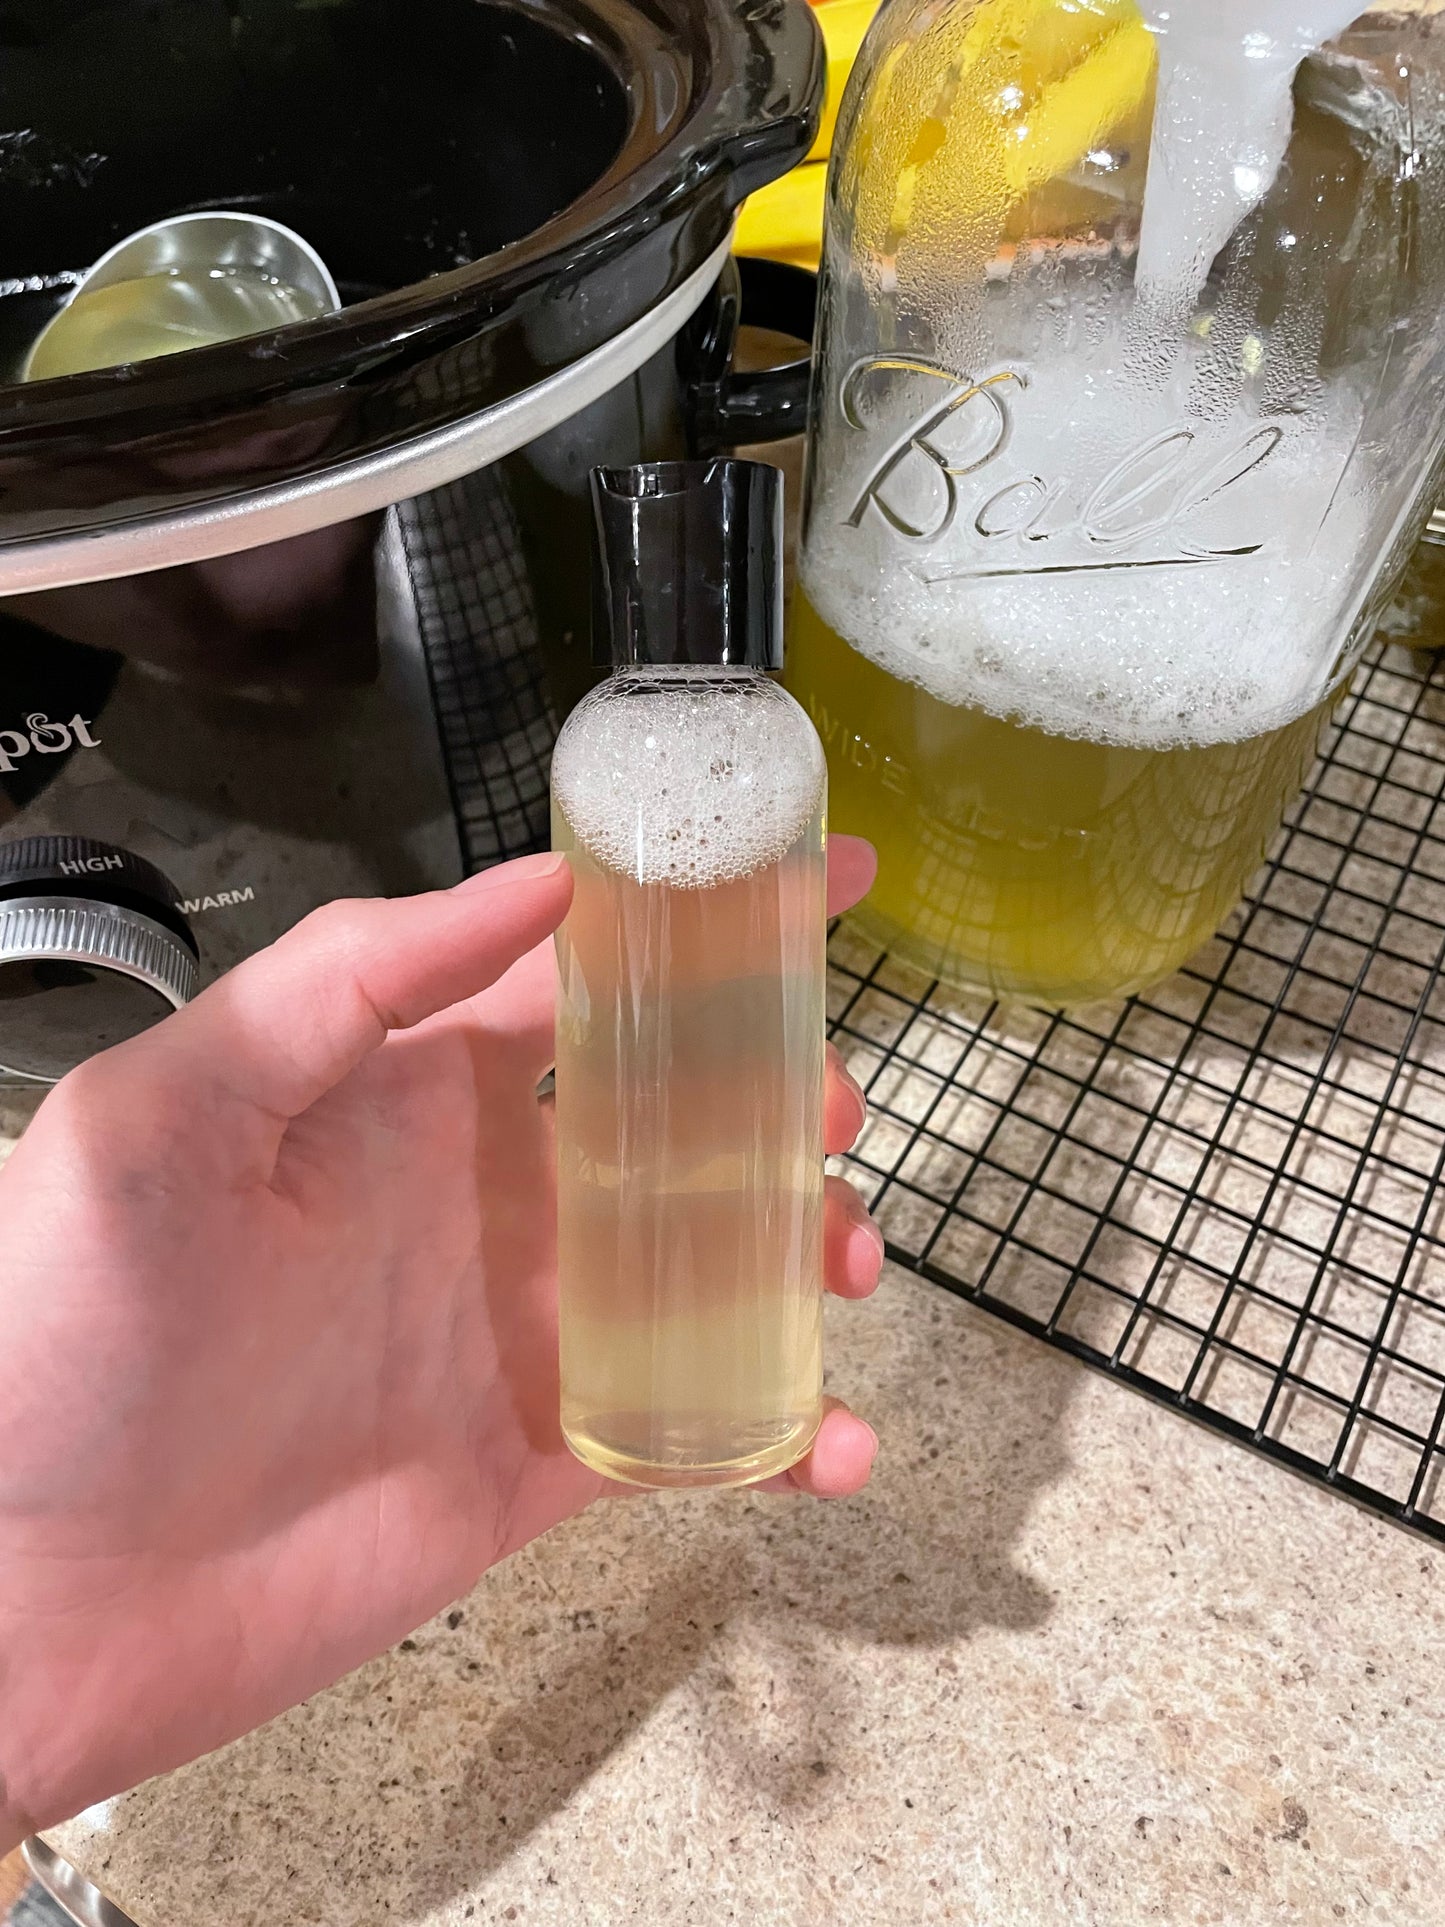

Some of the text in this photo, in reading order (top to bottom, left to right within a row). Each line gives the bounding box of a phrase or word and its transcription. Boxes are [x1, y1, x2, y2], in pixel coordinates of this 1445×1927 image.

[839, 352, 1283, 557] Ball
[59, 854, 125, 875] HIGH
[174, 886, 256, 915] WARM
